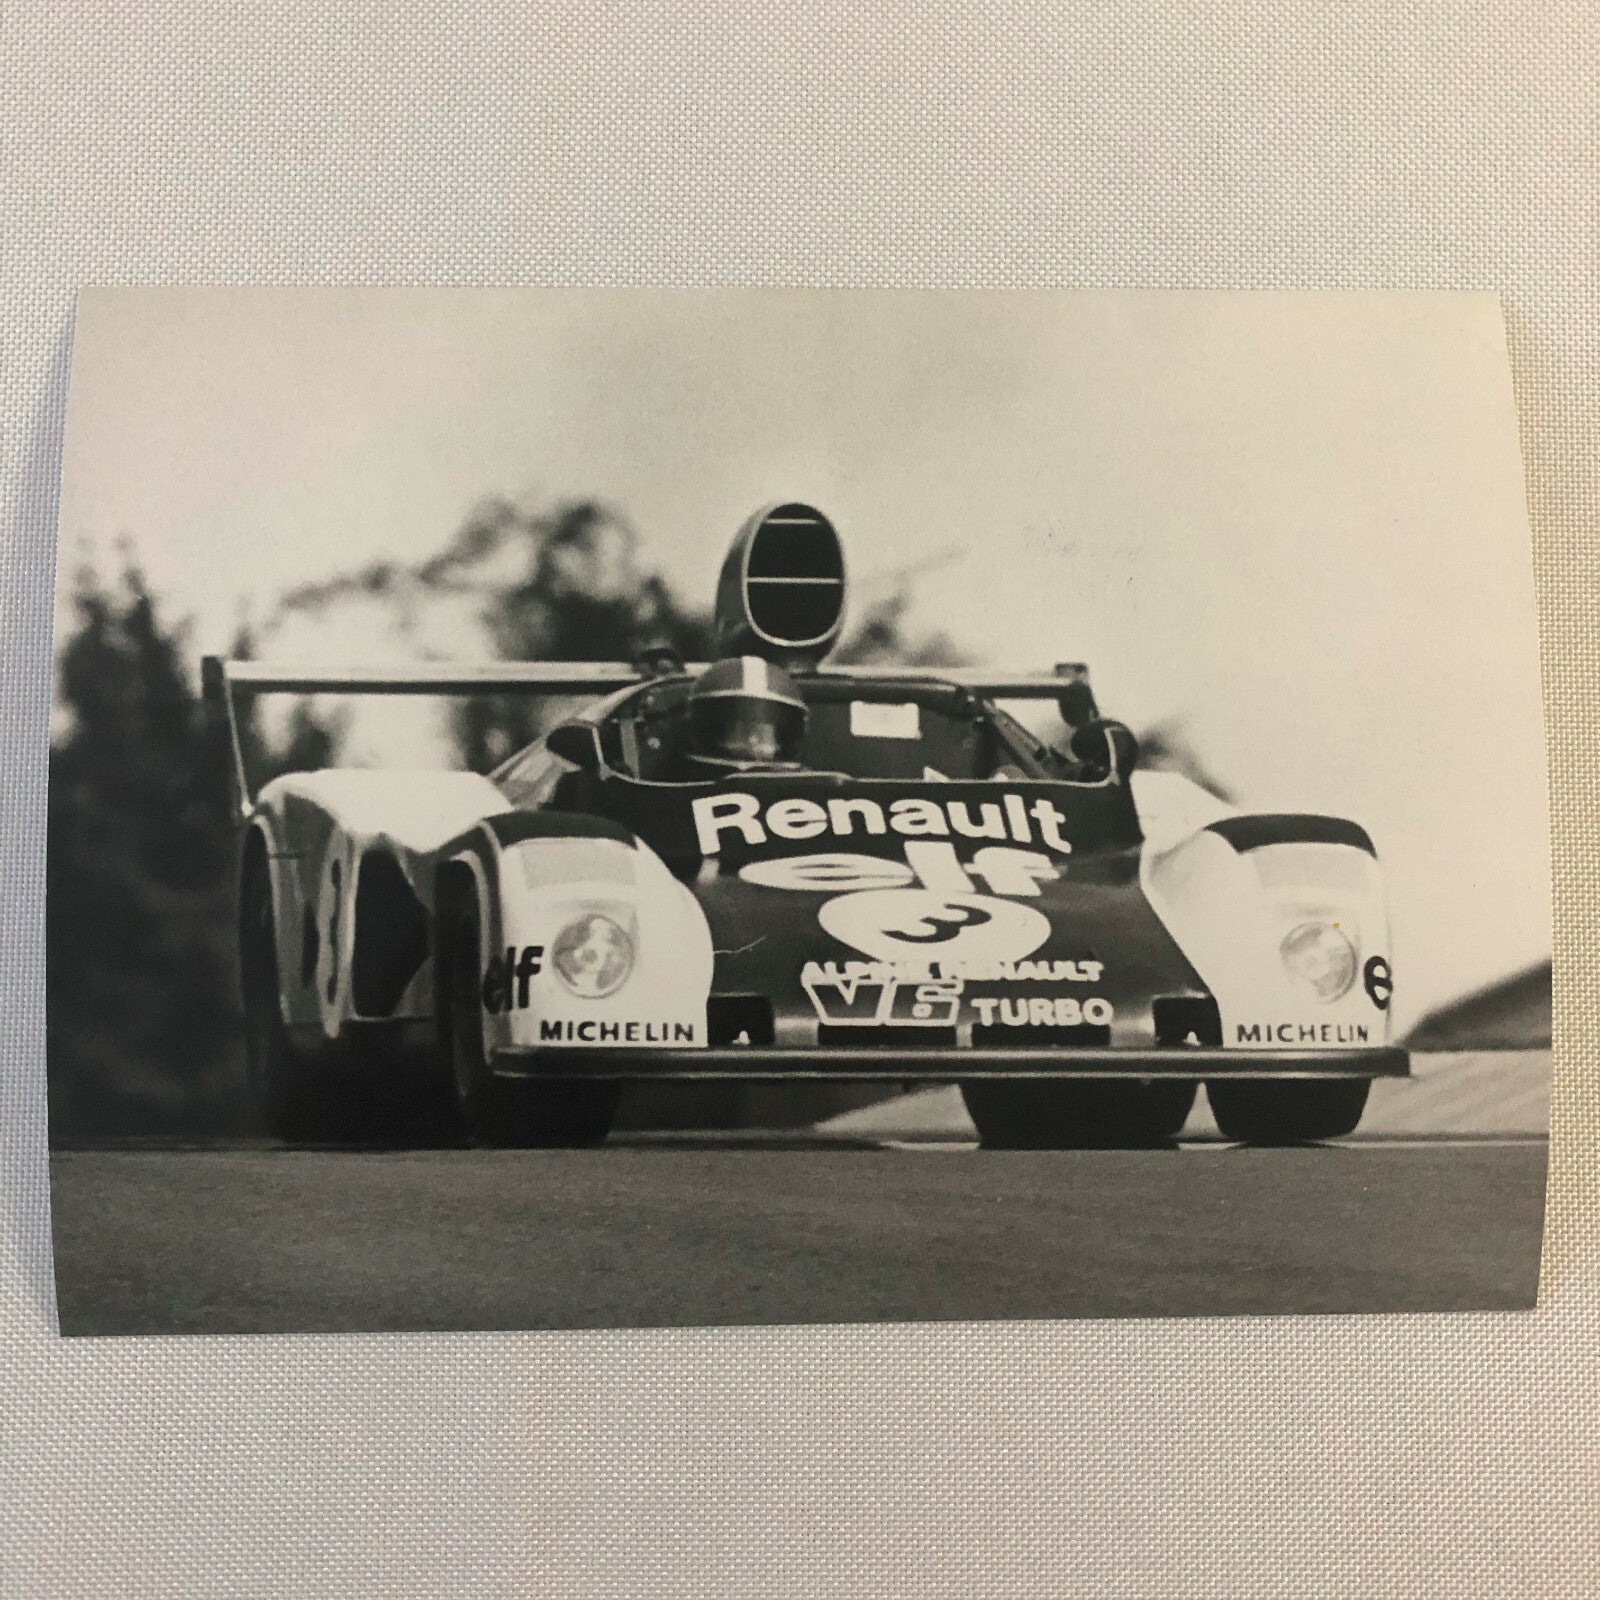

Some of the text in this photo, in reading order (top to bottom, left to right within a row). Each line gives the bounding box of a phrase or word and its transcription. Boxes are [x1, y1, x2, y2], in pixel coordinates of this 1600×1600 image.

[692, 792, 1072, 855] Renault
[739, 841, 1061, 896] elf
[881, 903, 992, 943] 3
[971, 997, 1114, 1027] TURBO
[541, 1019, 693, 1042] MICHELIN
[1237, 1023, 1368, 1042] MICHELIN
